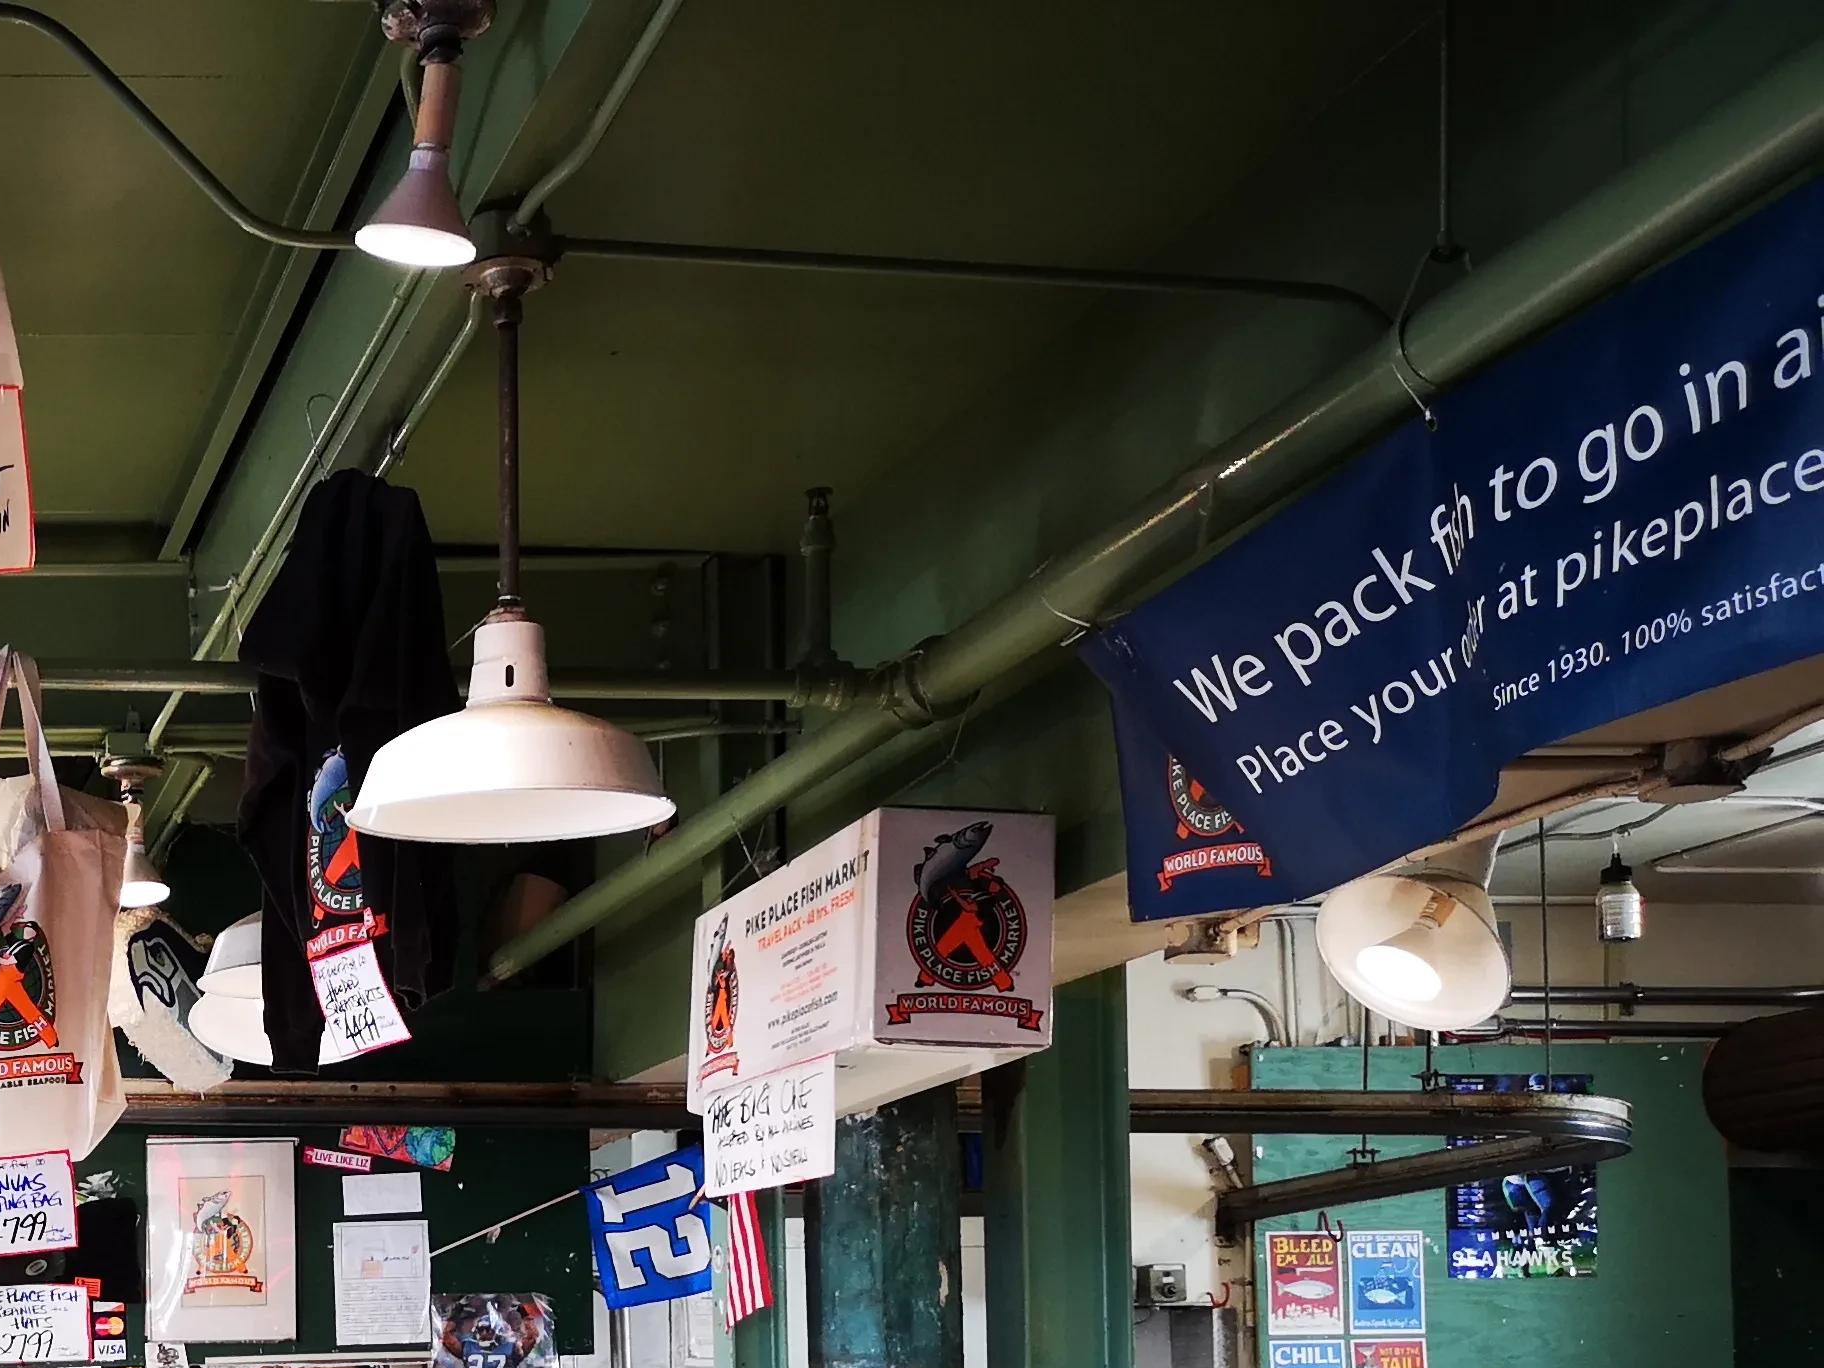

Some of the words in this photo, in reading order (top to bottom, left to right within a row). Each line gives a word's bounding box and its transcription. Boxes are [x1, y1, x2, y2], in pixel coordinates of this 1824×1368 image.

[1172, 650, 1274, 724] We
[1274, 546, 1437, 686] pack
[1429, 482, 1474, 576] fish
[1488, 455, 1558, 523] to
[1577, 403, 1664, 504] go
[1678, 361, 1749, 435] in
[1492, 671, 1541, 712] Since
[1547, 640, 1611, 684] 1930.
[1621, 607, 1693, 656] 100%
[1236, 718, 1350, 795] Place
[1349, 646, 1457, 745] your
[1497, 563, 1539, 620] at
[1176, 794, 1211, 831] PLACE
[1164, 851, 1206, 873] WORLD
[1209, 846, 1263, 865] FAMOUS
[309, 834, 321, 879] PIKE
[315, 874, 352, 910] PLACE
[745, 910, 767, 939] PIKE
[768, 892, 800, 927] PLACE
[800, 878, 823, 909] FISH
[757, 932, 783, 952] TRAVEL
[911, 907, 928, 949] PIKE
[922, 948, 962, 982] PLACE
[966, 963, 1000, 983] FISH
[1000, 898, 1021, 965] MARKET
[13, 1016, 48, 1044] FISH
[37, 946, 56, 1014] MARKET
[902, 996, 958, 1011] WORLD
[962, 997, 1030, 1016] FAMOUS
[12, 1055, 75, 1077] FAMOUS
[27, 1076, 66, 1088] SEAFOOD
[708, 1094, 738, 1134] THE
[739, 1082, 770, 1125] BIG
[314, 1150, 334, 1164] LIVE
[334, 1154, 355, 1167] LIKE
[355, 1157, 370, 1169] LIZ
[30, 1190, 63, 1209] BAG
[594, 1162, 713, 1291] 12
[1273, 1237, 1334, 1254] BLEED
[1351, 1241, 1420, 1259] CLEAN
[1306, 1253, 1335, 1266] ALL
[1452, 1249, 1574, 1268] SEAHAWKS
[6, 1288, 46, 1304] PLACE
[50, 1289, 81, 1302] FISH
[10, 1316, 54, 1330] HATS
[98, 1344, 125, 1355] VISA
[1274, 1346, 1342, 1366] CHILL
